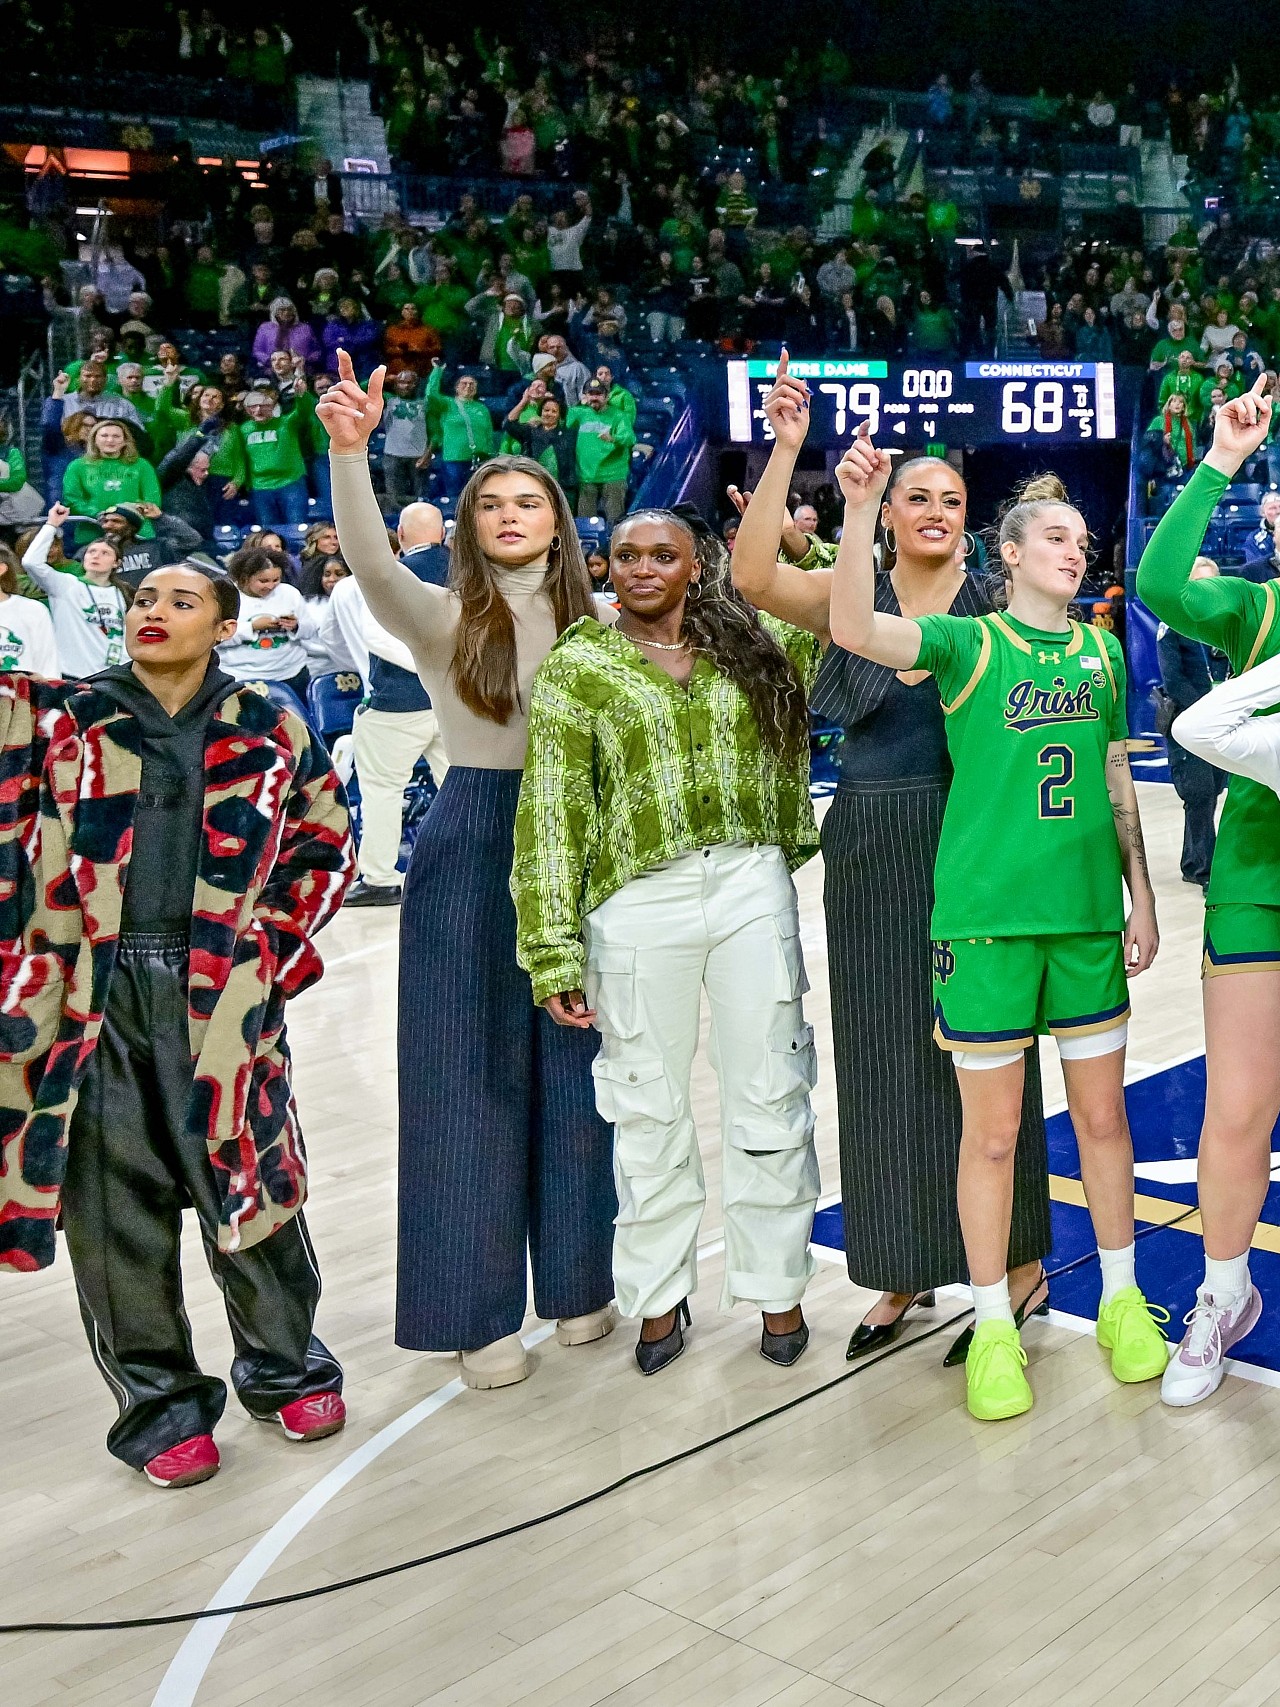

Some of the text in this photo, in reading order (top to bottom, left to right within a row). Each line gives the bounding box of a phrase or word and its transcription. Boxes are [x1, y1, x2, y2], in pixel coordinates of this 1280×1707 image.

[766, 363, 869, 377] NTRE DAME
[979, 365, 1083, 377] CONNECTICUT
[819, 384, 880, 436] 79
[924, 421, 935, 437] 4
[1002, 382, 1064, 434] 68
[1004, 676, 1100, 721] Irish
[1038, 744, 1075, 819] 2
